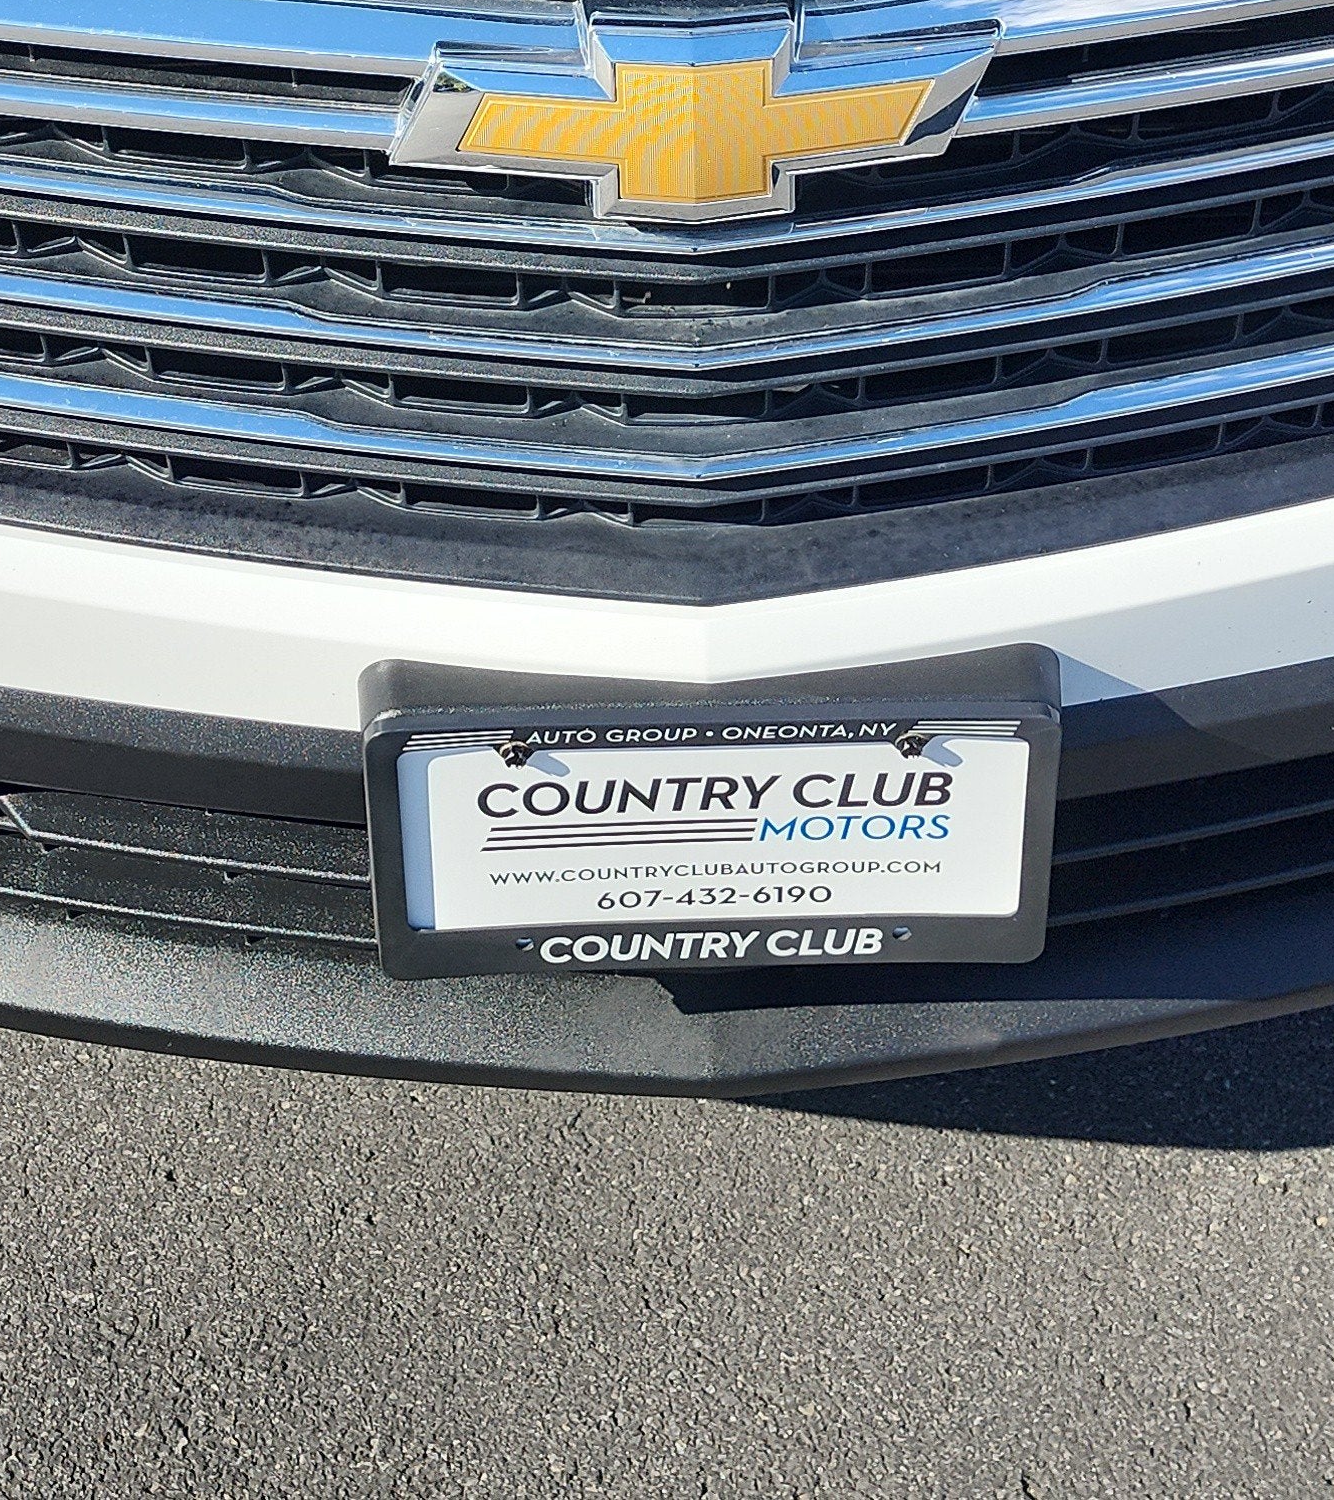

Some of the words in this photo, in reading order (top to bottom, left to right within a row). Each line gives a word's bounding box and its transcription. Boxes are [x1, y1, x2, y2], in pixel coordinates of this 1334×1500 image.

[526, 729, 597, 745] AUTO
[605, 728, 698, 744] GROUP
[478, 775, 785, 819] COUNTRY
[792, 771, 954, 808] CLUB
[759, 814, 951, 842] MOTORS
[489, 860, 942, 886] WWW.COUNTRYCLUBAUTOGROUP.COM
[597, 885, 833, 910] 607-432-6190
[539, 930, 760, 964] COUNTRY
[766, 927, 883, 956] CLUB
